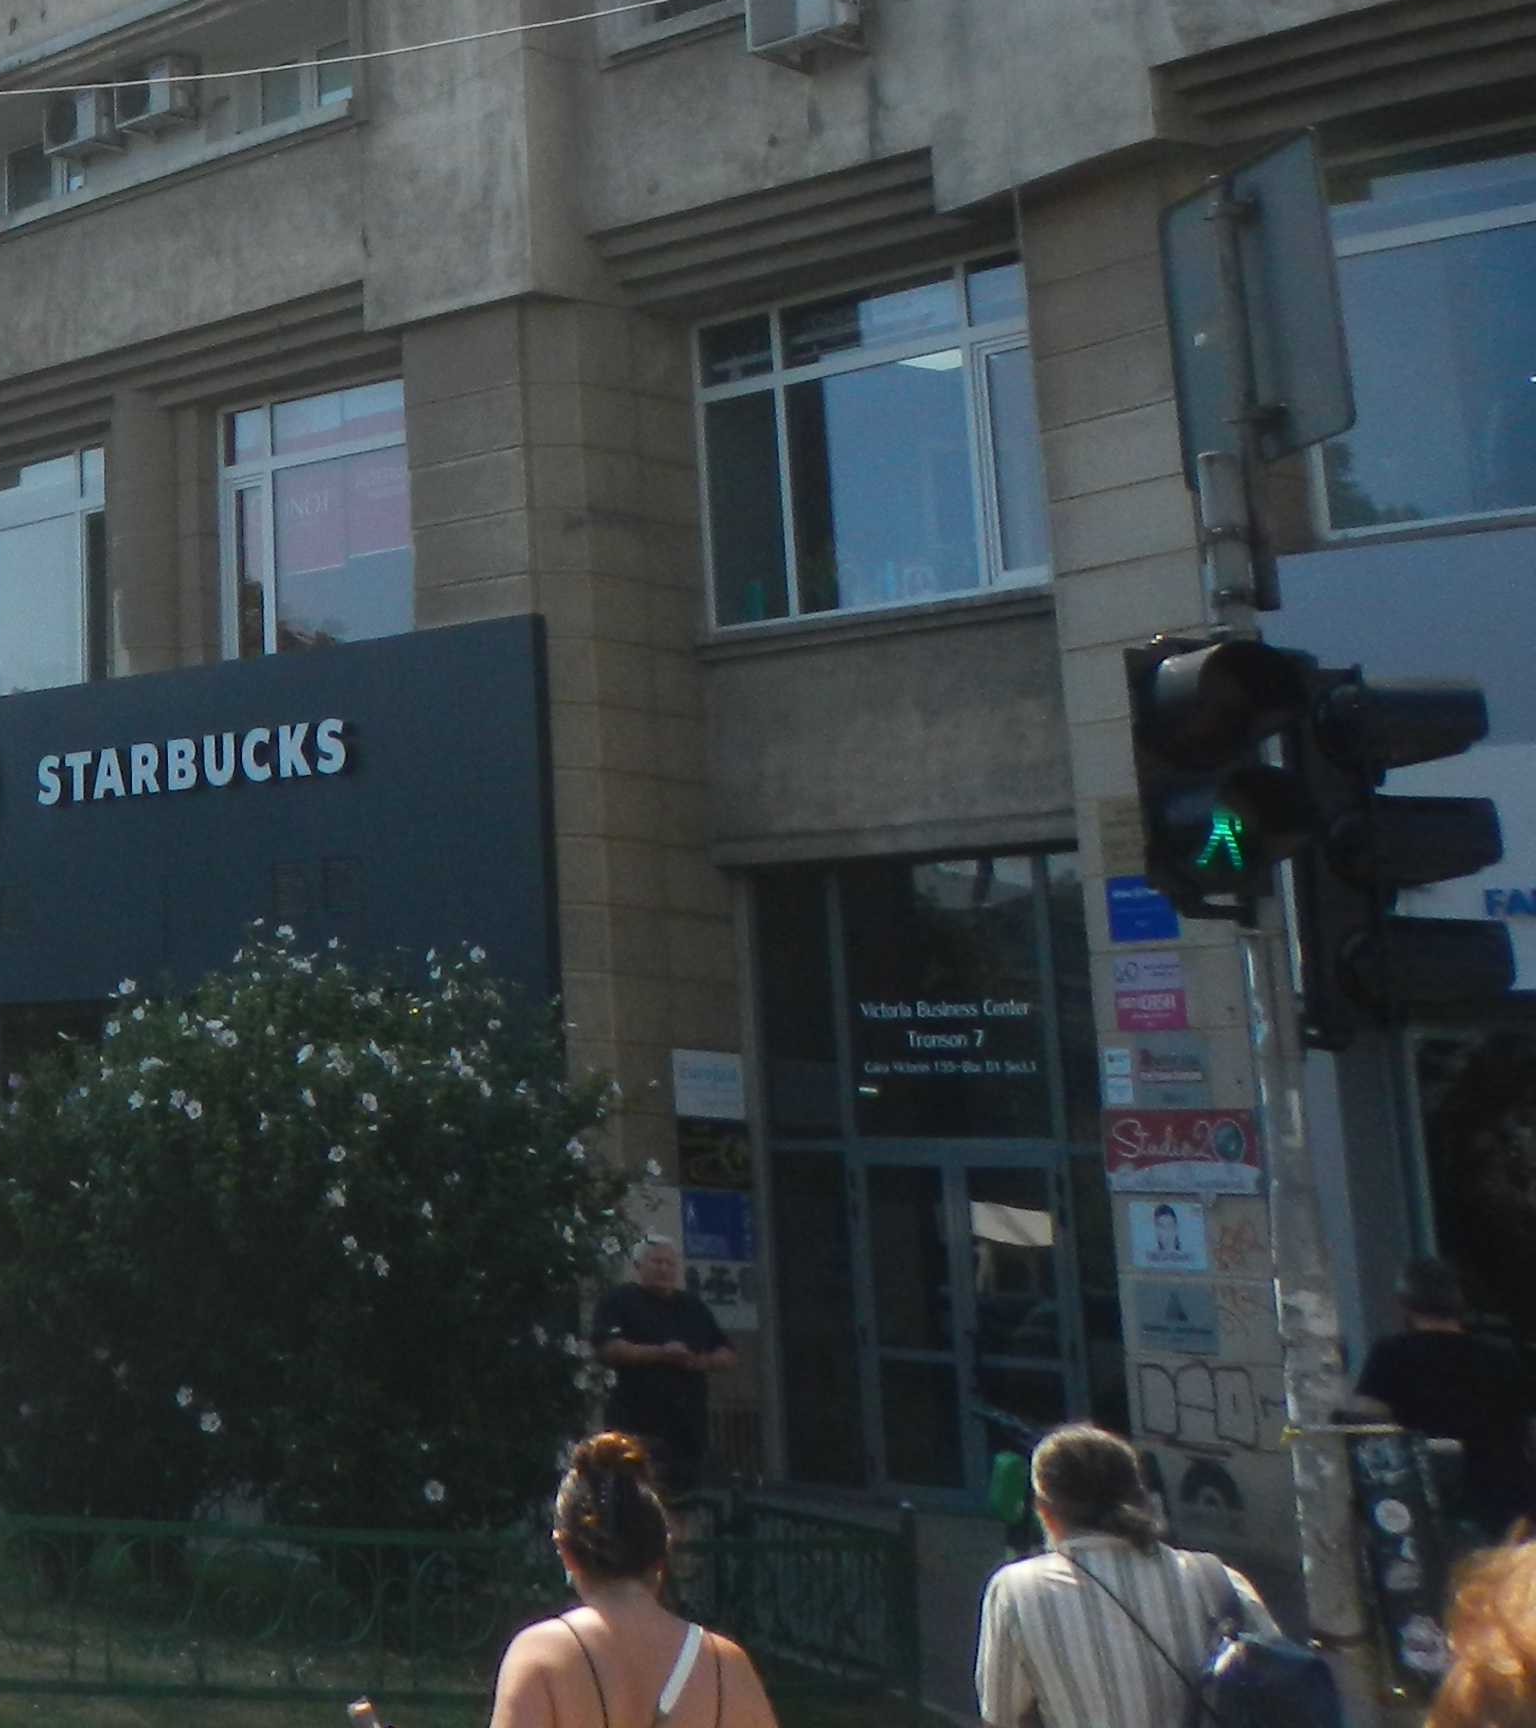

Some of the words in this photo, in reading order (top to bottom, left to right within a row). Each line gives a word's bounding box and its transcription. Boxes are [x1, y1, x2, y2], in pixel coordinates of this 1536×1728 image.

[36, 717, 348, 807] STARBUCKS
[1484, 888, 1536, 917] FA
[860, 1001, 913, 1019] Victoria
[916, 1000, 978, 1018] Business
[982, 999, 1030, 1017] Center
[907, 1029, 968, 1049] Tronson
[972, 1028, 985, 1048] 7
